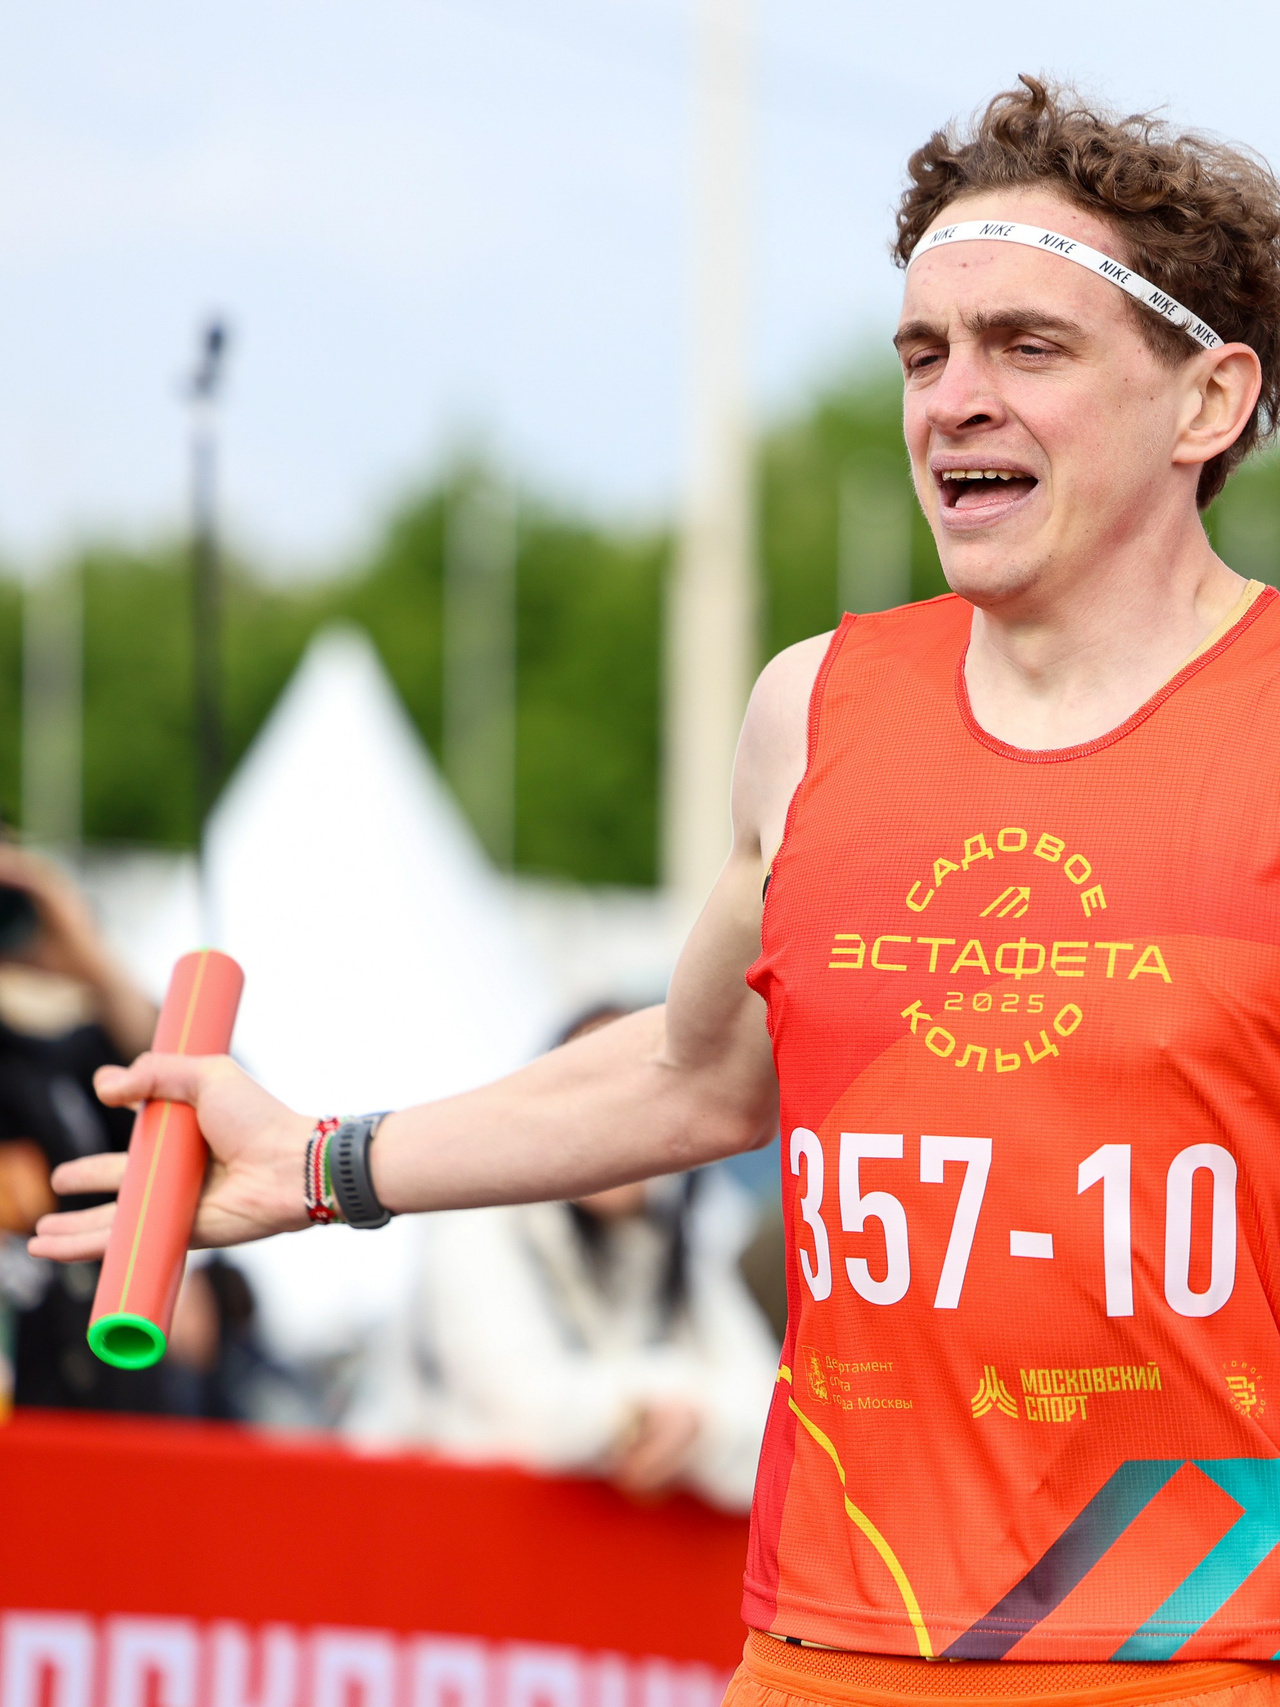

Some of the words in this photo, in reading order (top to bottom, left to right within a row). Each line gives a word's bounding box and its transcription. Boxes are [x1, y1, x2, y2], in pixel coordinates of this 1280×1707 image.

[929, 225, 959, 244] NIKE
[979, 223, 1015, 237] NIKE
[1039, 233, 1077, 254] NIKE
[1098, 260, 1132, 284] NIKE
[1148, 291, 1179, 317] NIKE
[1192, 323, 1218, 348] NIKE
[905, 827, 1107, 918] САДОВОЕ
[828, 933, 1173, 984] ЭСТАФЕТА
[944, 991, 1045, 1014] 2025
[900, 999, 1084, 1073] КОЛЬЦО
[789, 1126, 1238, 1318] 357-10
[857, 1396, 914, 1410] Москвы
[1019, 1361, 1162, 1395] МОСКОВСКИЙ
[1025, 1395, 1088, 1423] СПОРТ
